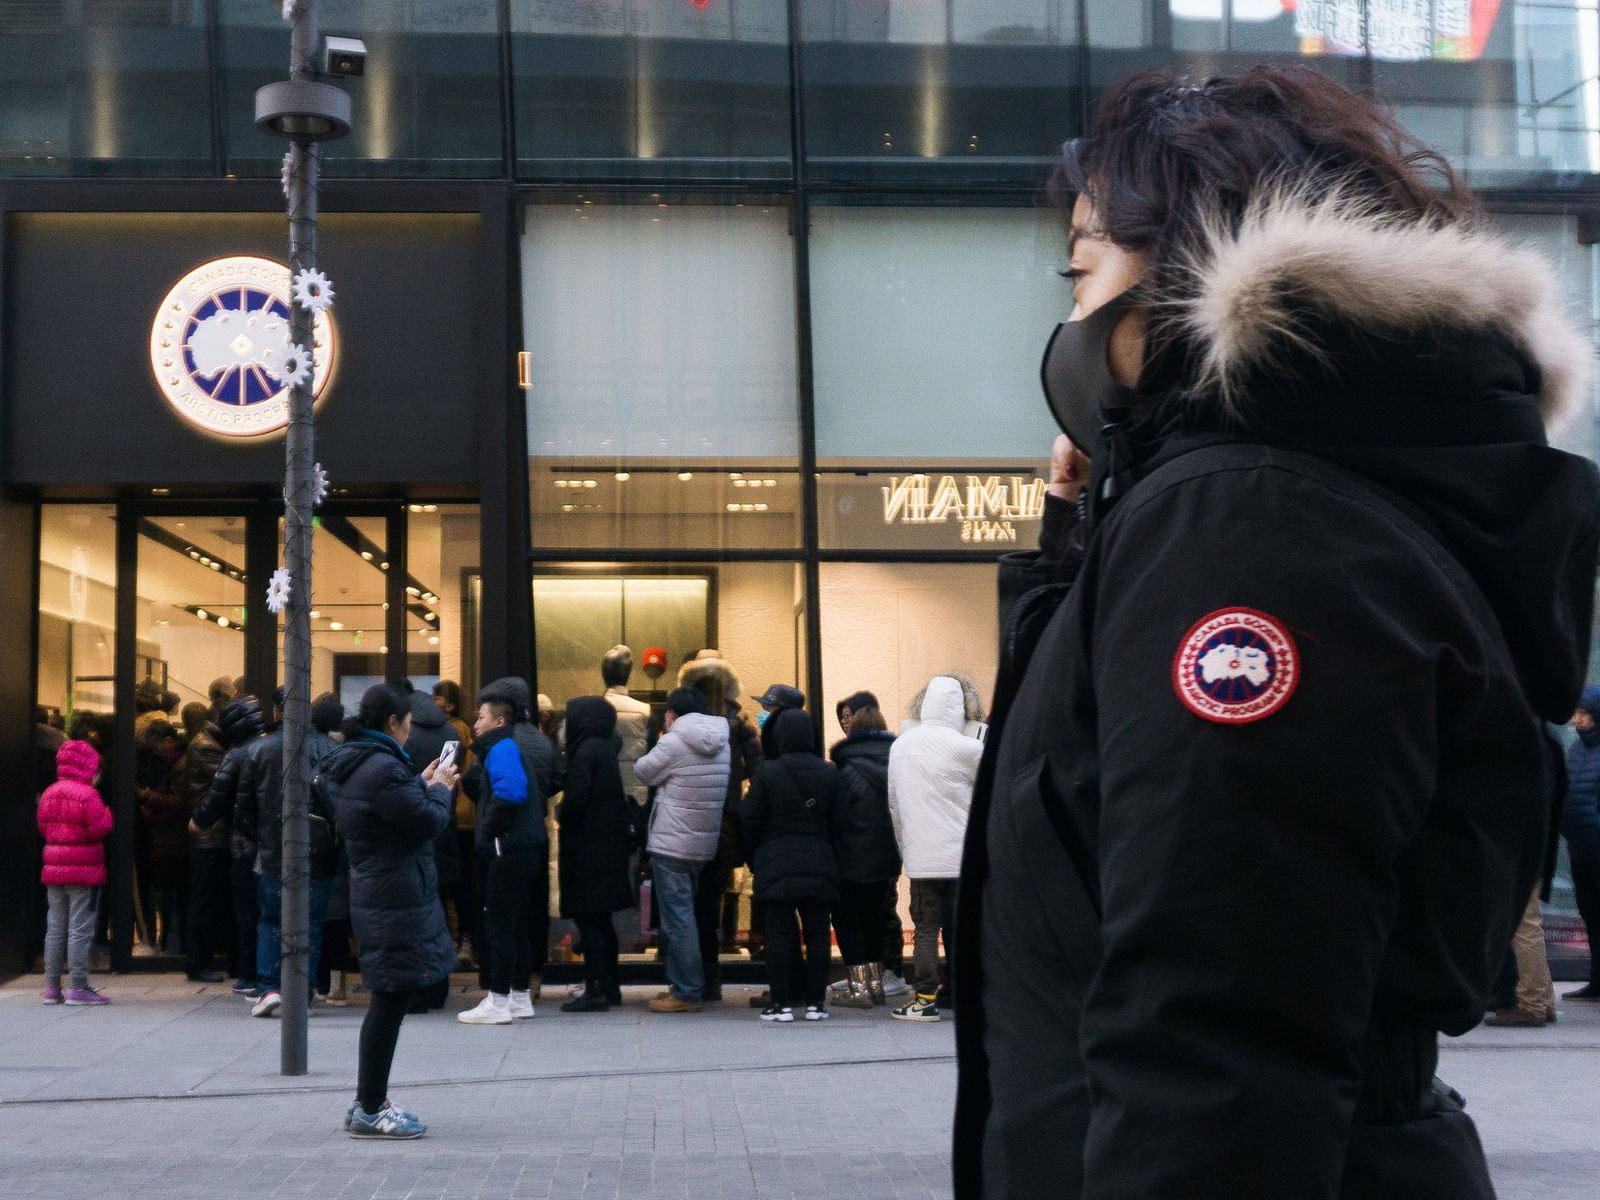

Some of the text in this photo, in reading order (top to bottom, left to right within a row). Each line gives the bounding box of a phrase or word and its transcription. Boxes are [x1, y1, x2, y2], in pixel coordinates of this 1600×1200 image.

[188, 265, 291, 293] CANADA GOOS
[180, 392, 291, 424] ARCTIC PROGRA
[375, 1117, 397, 1133] N
